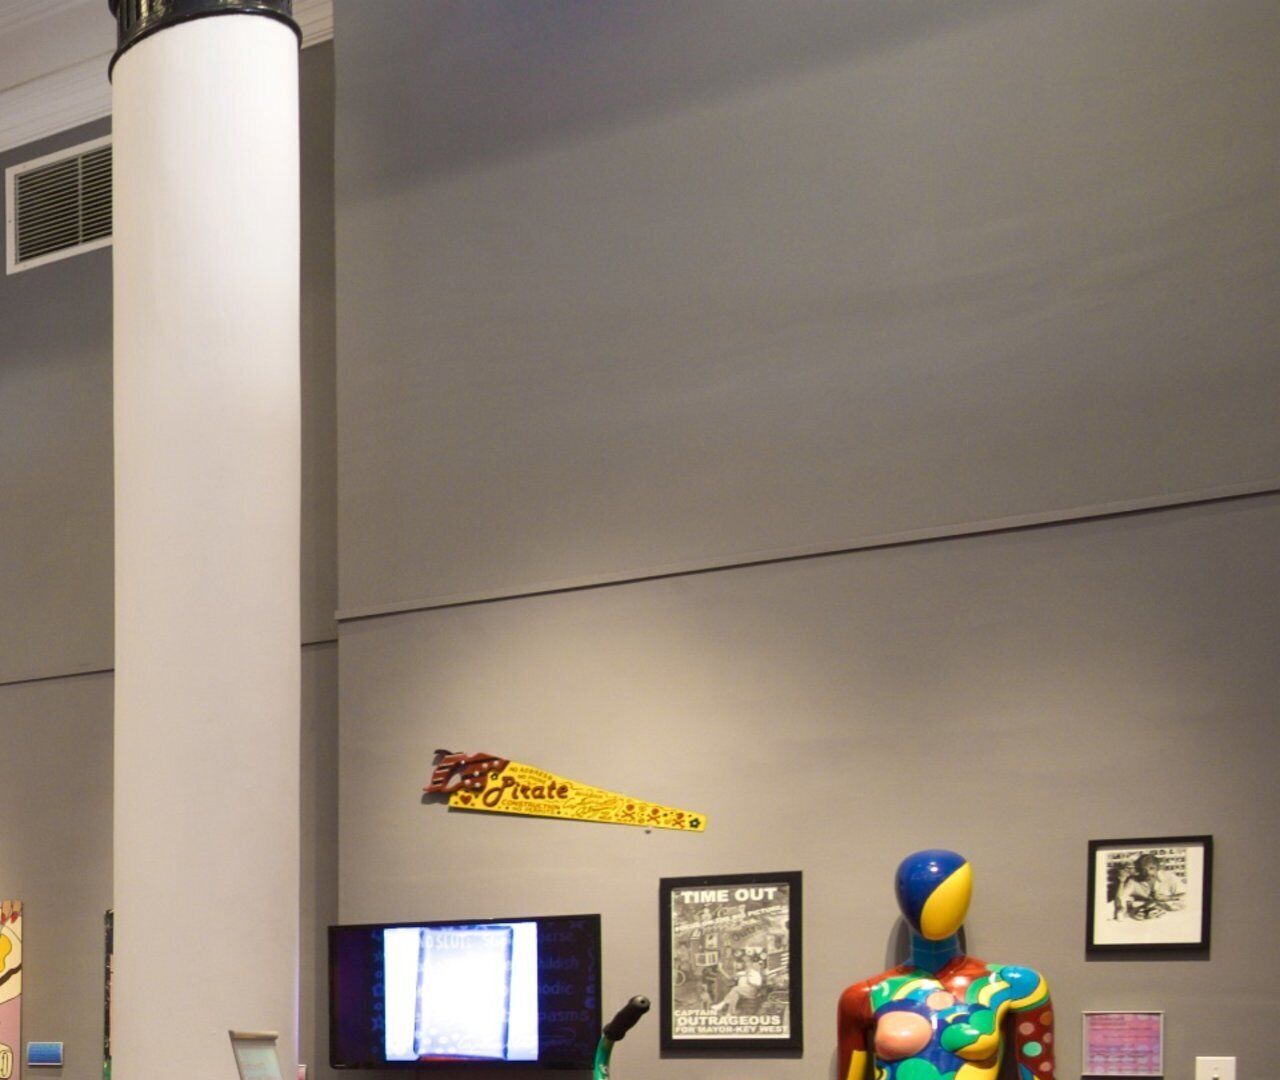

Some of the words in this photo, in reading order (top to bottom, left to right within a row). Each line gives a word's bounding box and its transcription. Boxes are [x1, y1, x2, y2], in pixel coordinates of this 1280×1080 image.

[483, 776, 569, 807] Pirate
[680, 890, 729, 904] TIME
[735, 888, 777, 902] OUT
[677, 1015, 781, 1026] OUTRAGEOUS
